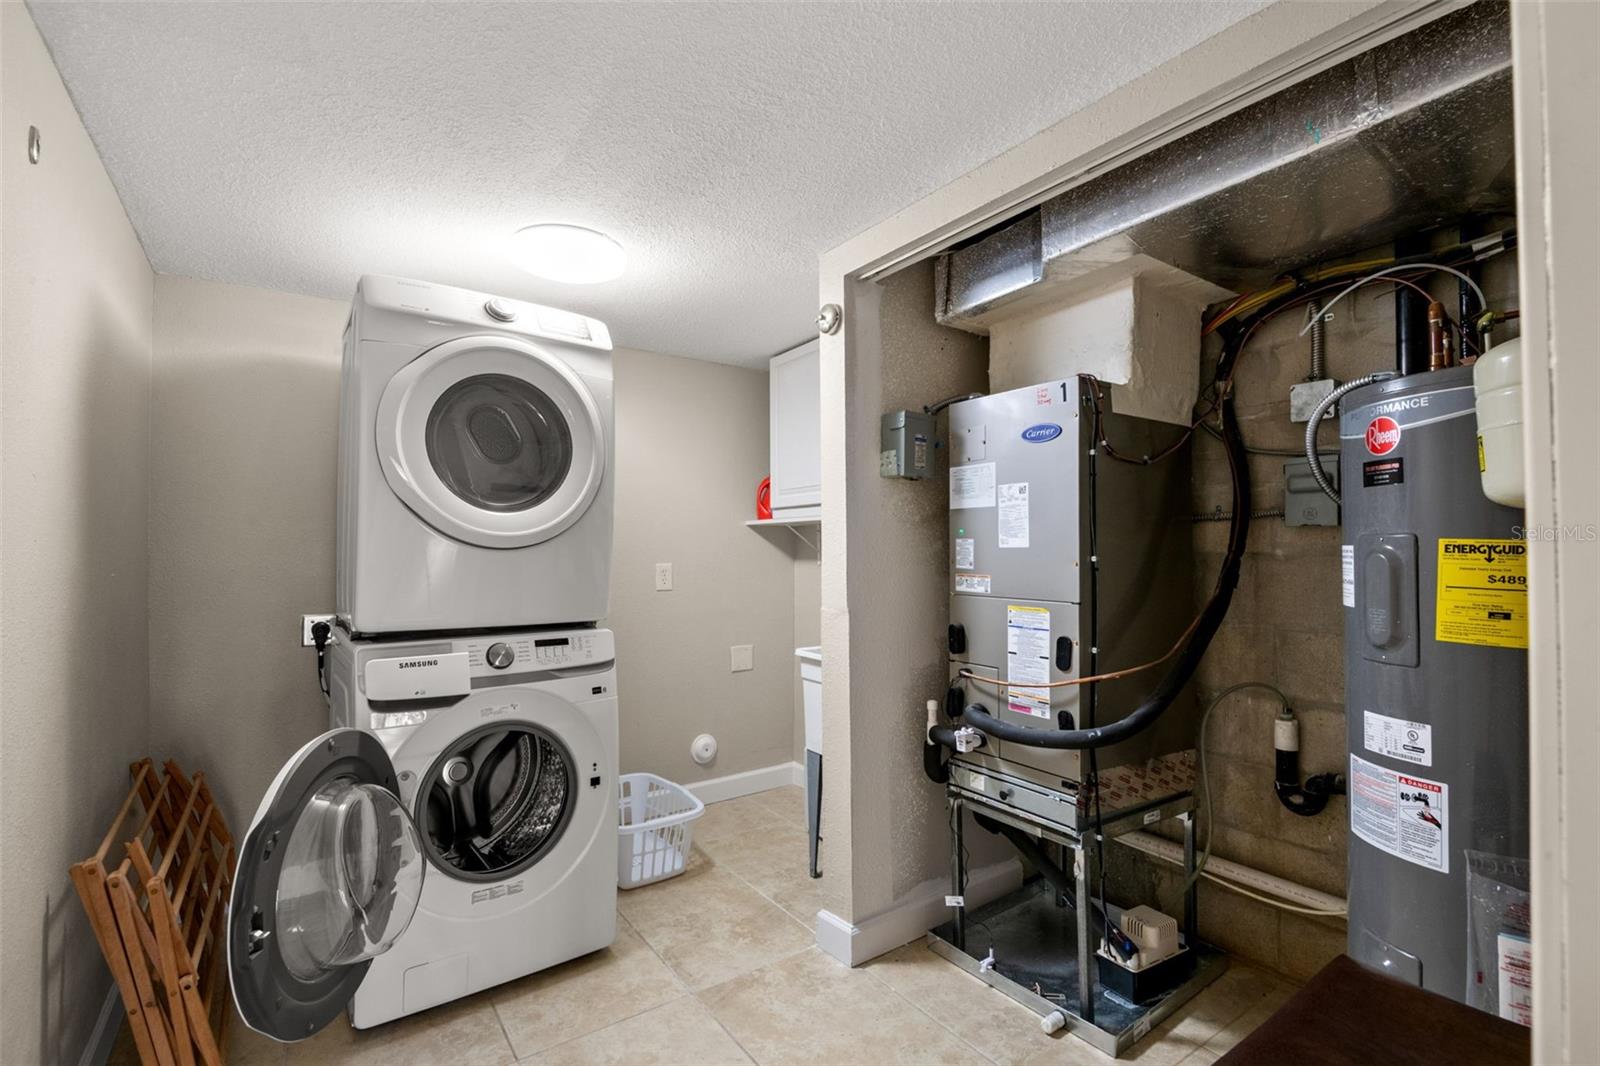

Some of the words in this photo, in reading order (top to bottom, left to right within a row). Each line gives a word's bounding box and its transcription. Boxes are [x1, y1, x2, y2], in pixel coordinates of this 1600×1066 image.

[1060, 382, 1067, 402] 1
[1026, 426, 1055, 438] Carrier
[1368, 420, 1398, 449] Rheem
[398, 659, 438, 669] SAMSUNG
[1407, 779, 1440, 792] DANGER
